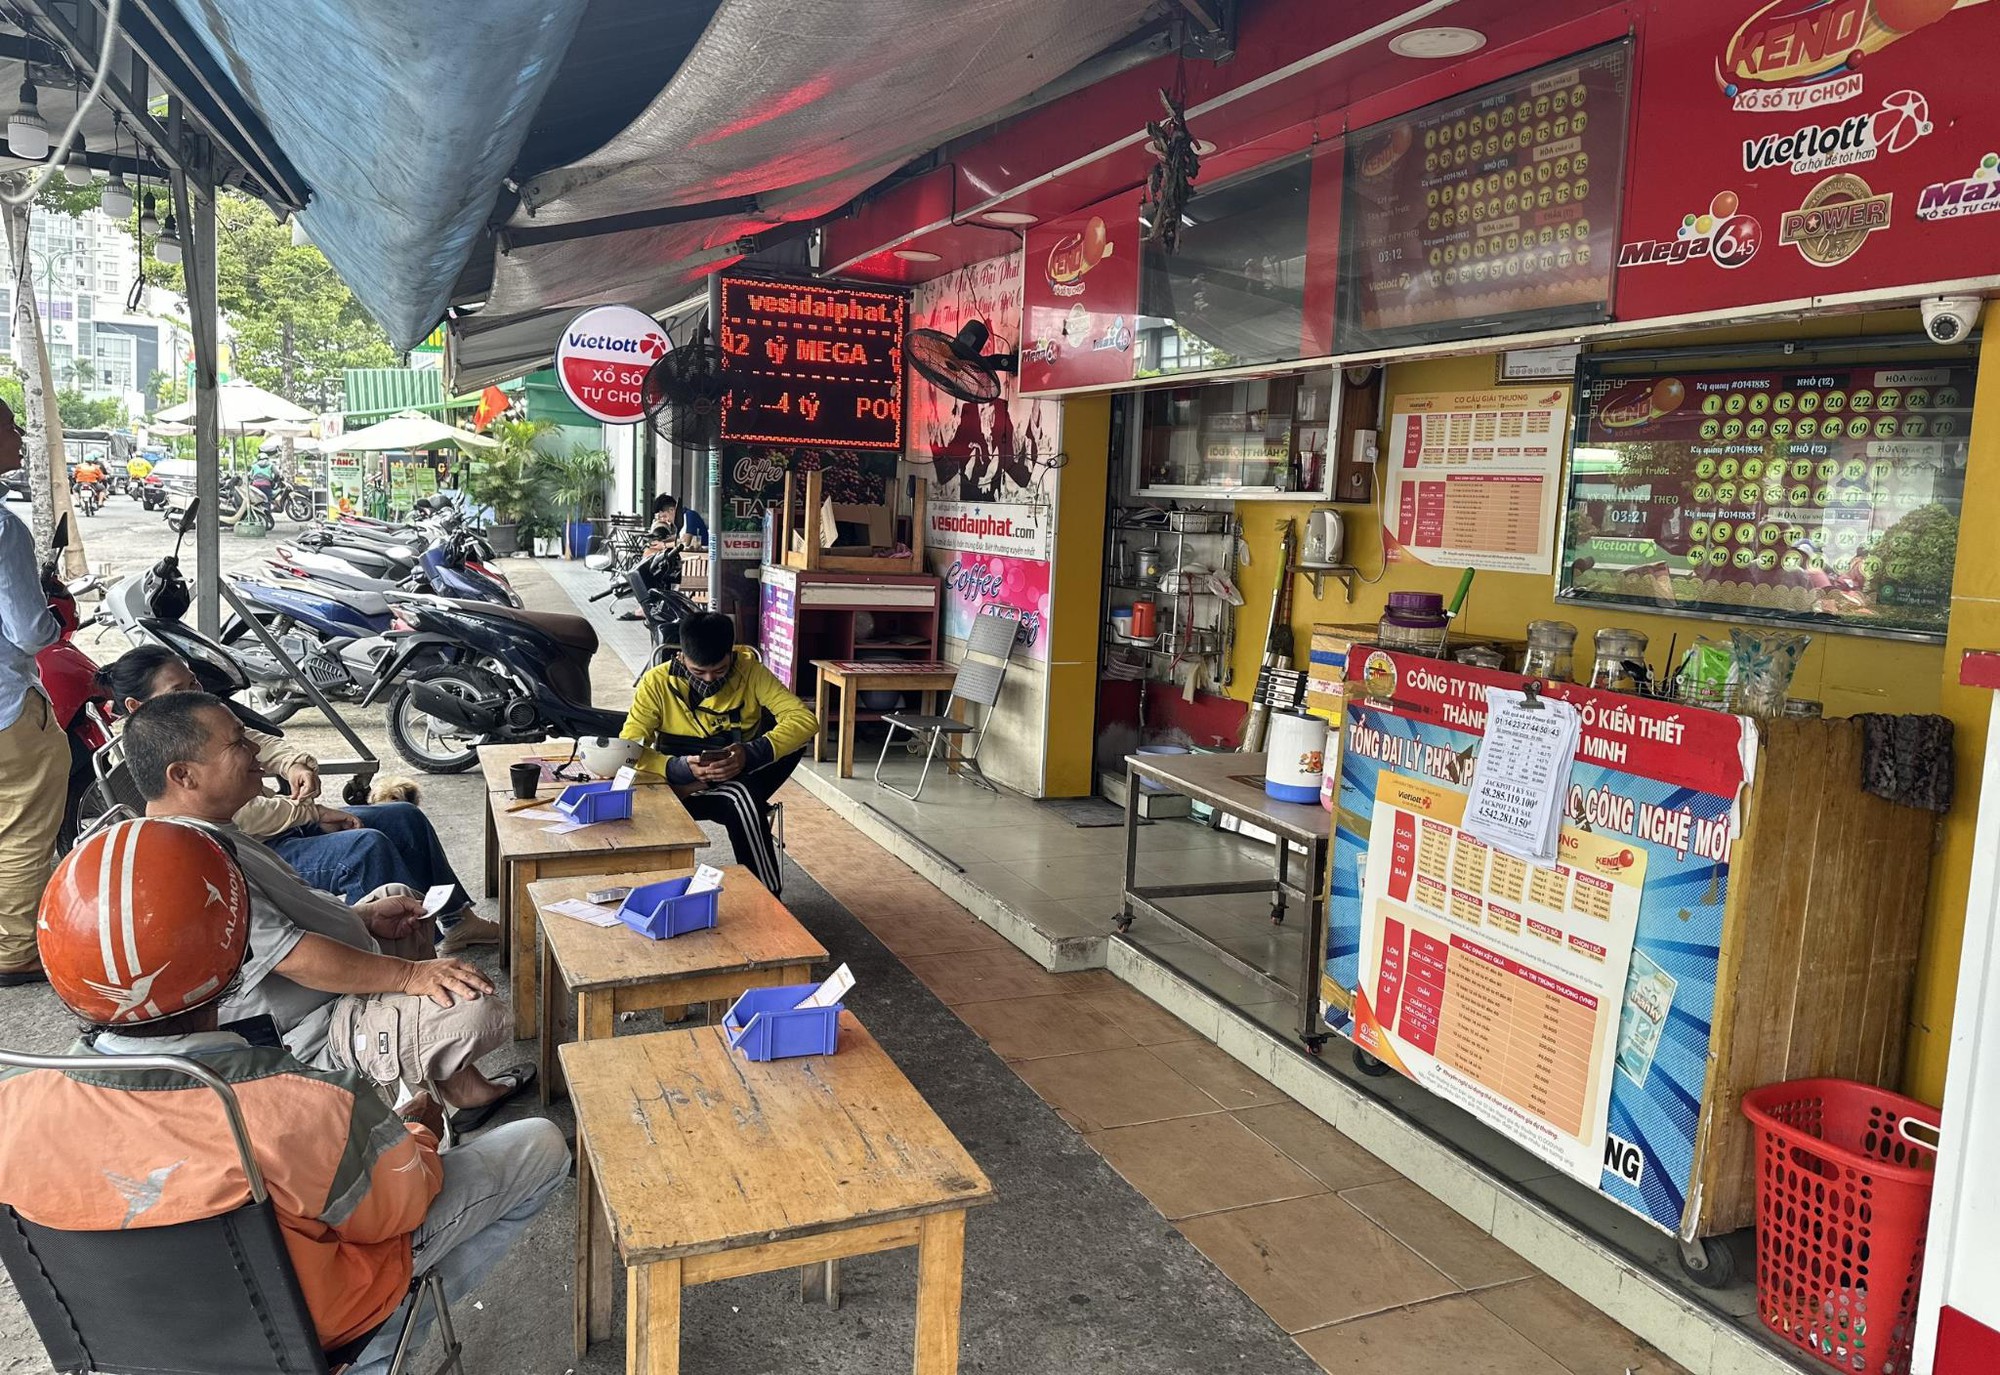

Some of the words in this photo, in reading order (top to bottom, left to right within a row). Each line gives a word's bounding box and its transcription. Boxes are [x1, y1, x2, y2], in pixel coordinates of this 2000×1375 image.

[1727, 3, 1863, 74] KENO
[1788, 89, 1806, 109] TỰ
[1809, 76, 1861, 103] CHỌN
[1538, 102, 1548, 112] 27
[1574, 92, 1585, 102] 36
[1538, 127, 1549, 137] 75
[1556, 122, 1567, 133] 77
[1574, 117, 1585, 127] 79
[1746, 115, 1869, 170] Vietlott
[1541, 167, 1549, 177] 19
[1557, 163, 1568, 173] 24
[1575, 158, 1586, 169] 25
[1540, 192, 1550, 202] 72
[1557, 188, 1568, 198] 75
[1576, 184, 1587, 194] 79
[1786, 200, 1887, 238] POWER
[1378, 248, 1402, 263] 03:12
[1620, 237, 1709, 265] Mega
[569, 333, 638, 353] Vietlott
[796, 339, 868, 365] MEGA
[592, 365, 616, 383] XỔ
[620, 369, 644, 385] SỐ
[1796, 376, 1816, 387] NHỎ
[1817, 377, 1835, 388] (12)
[1731, 380, 1770, 389] #0141885
[581, 386, 602, 403] TỰ
[1710, 400, 1715, 411] 1
[1731, 399, 1740, 410] 2
[1755, 399, 1763, 410] 8
[1778, 398, 1791, 409] 15
[1803, 397, 1816, 409] 19
[1827, 396, 1844, 408] 20
[1853, 396, 1871, 408] 22
[1881, 395, 1899, 407] 27
[1909, 394, 1927, 406] 28
[1938, 393, 1956, 405] 36
[1703, 425, 1716, 435] 38
[1726, 424, 1740, 435] 39
[1749, 424, 1764, 435] 44
[1773, 424, 1789, 435] 52
[1799, 423, 1814, 435] 53
[1824, 423, 1841, 435] 64
[1850, 422, 1867, 434] 69
[1878, 422, 1895, 434] 75
[1905, 422, 1922, 434] 77
[1724, 445, 1764, 454] #0141884
[1789, 443, 1809, 453] NHỎ
[1811, 444, 1828, 455] (12)
[733, 457, 784, 491] Coffee
[1702, 463, 1710, 475] 2
[1725, 464, 1733, 475] 3
[1748, 463, 1757, 475] 4
[1772, 464, 1781, 475] 5
[1796, 463, 1809, 475] 13
[1821, 465, 1834, 477] 14
[1848, 465, 1861, 476] 18
[1876, 464, 1889, 476] 19
[1696, 488, 1711, 500] 26
[1719, 488, 1734, 500] 35
[1742, 489, 1758, 500] 54
[1766, 489, 1781, 500] 55
[1791, 489, 1807, 501] 64
[1611, 510, 1648, 524] 03:21
[1718, 510, 1756, 520] #0141883
[931, 513, 1035, 540] vesodaiphat.com
[1695, 526, 1704, 537] 4
[1718, 528, 1727, 538] 5
[1742, 529, 1750, 539] 9
[1764, 529, 1777, 540] 10
[1592, 540, 1636, 552] Vietlott
[1690, 550, 1705, 561] 48
[1712, 551, 1727, 563] 49
[1736, 554, 1751, 564] 50
[1760, 554, 1775, 566] 54
[1811, 557, 1825, 569] 61
[945, 560, 1003, 601] Coffee
[1406, 668, 1448, 694] CÔNG
[1450, 678, 1467, 698] TY
[1599, 704, 1635, 735] KIẾN
[1639, 713, 1686, 746] THIẾT
[1512, 720, 1520, 728] 23
[1521, 722, 1530, 730] 27
[1531, 724, 1539, 732] 44
[1540, 725, 1548, 733] 50
[1550, 727, 1560, 737] 43
[1584, 735, 1628, 765] MINH
[1350, 713, 1379, 759] TỔNG
[1382, 733, 1404, 774] ĐẠI
[1404, 734, 1423, 771] LÝ
[1586, 784, 1635, 836] CÔNG
[1637, 803, 1692, 862] NGHỆ
[1694, 814, 1732, 864] MỚI
[1485, 778, 1511, 792] JACKPOT
[1398, 790, 1422, 804] Vietlott
[1481, 798, 1507, 812] JACKPOT
